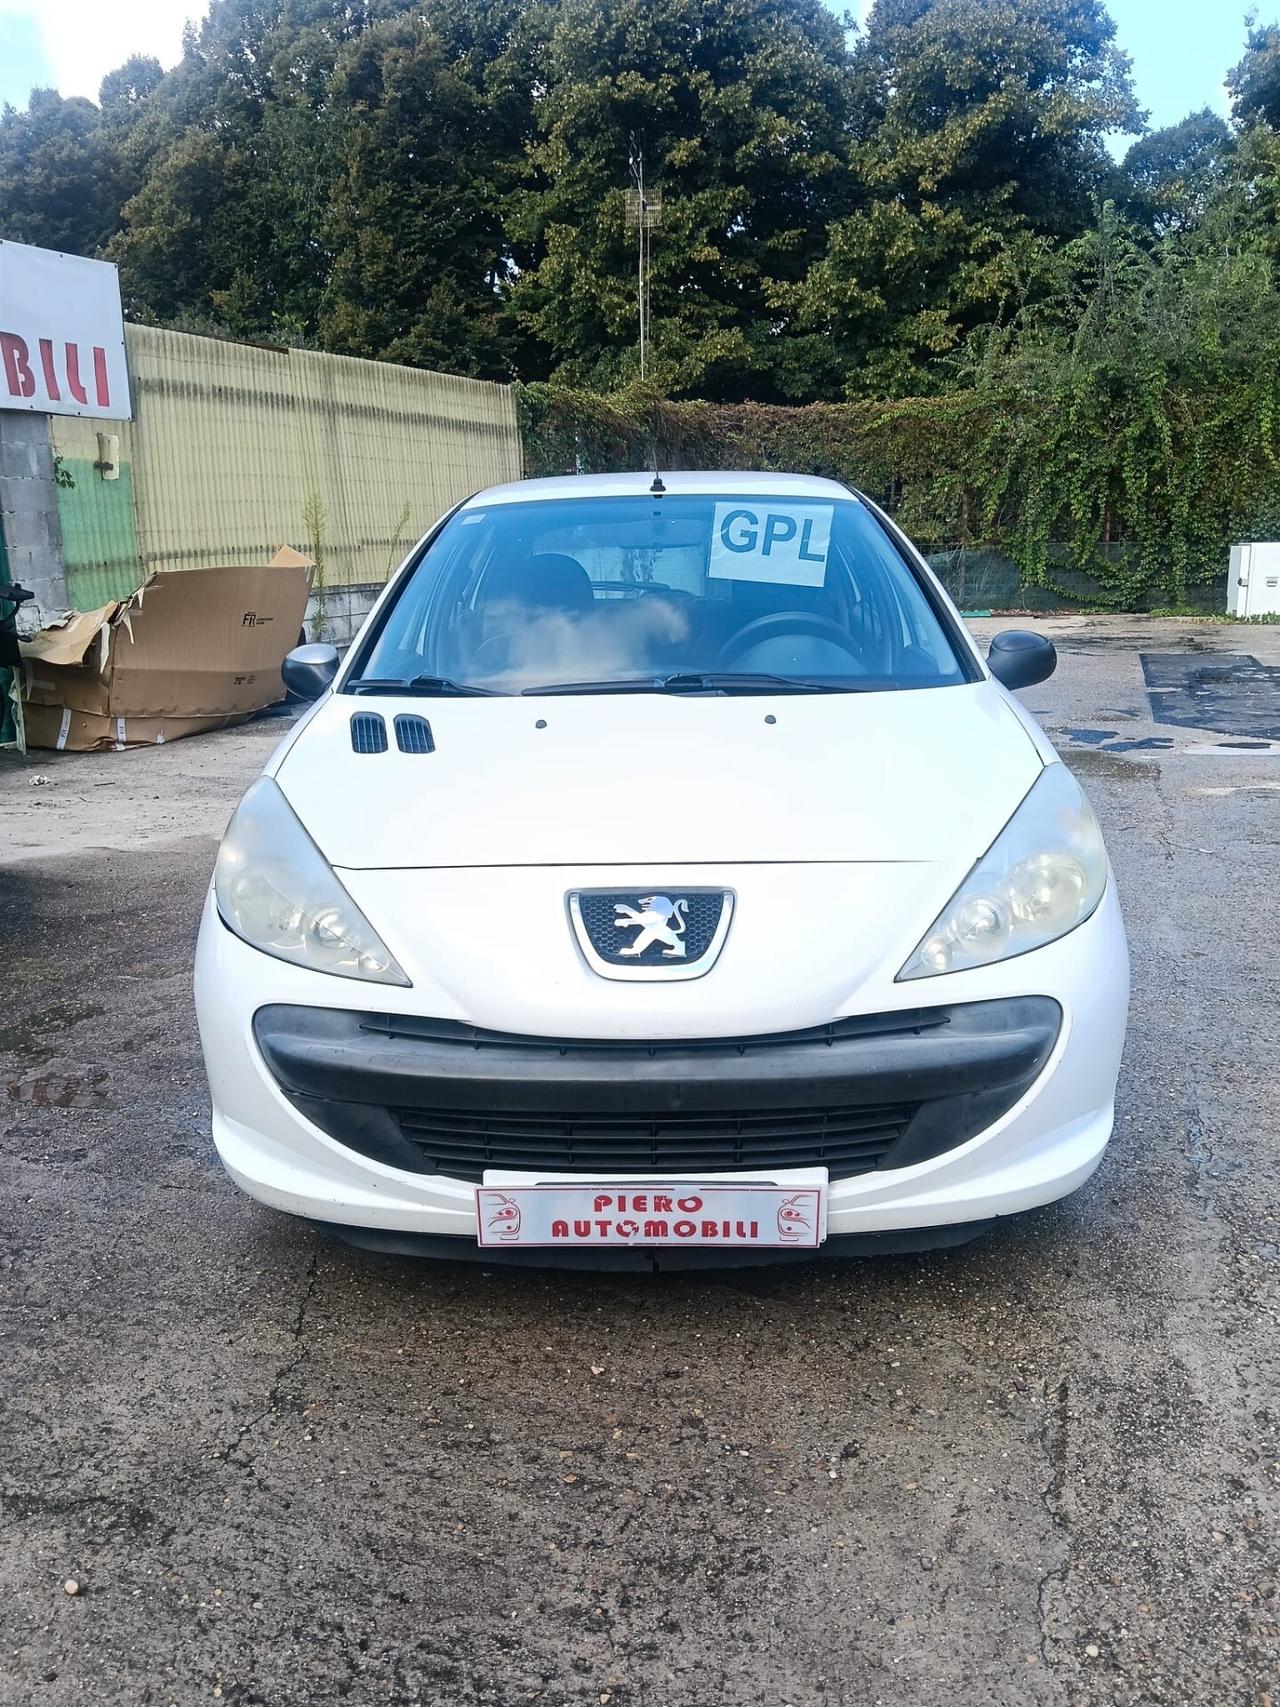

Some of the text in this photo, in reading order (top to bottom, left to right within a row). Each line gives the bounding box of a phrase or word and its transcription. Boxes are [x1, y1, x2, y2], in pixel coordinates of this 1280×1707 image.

[0, 331, 110, 407] BILI
[721, 509, 825, 563] GPL
[594, 1195, 703, 1213] PIERO
[552, 1220, 758, 1238] AUTOMOBILI
